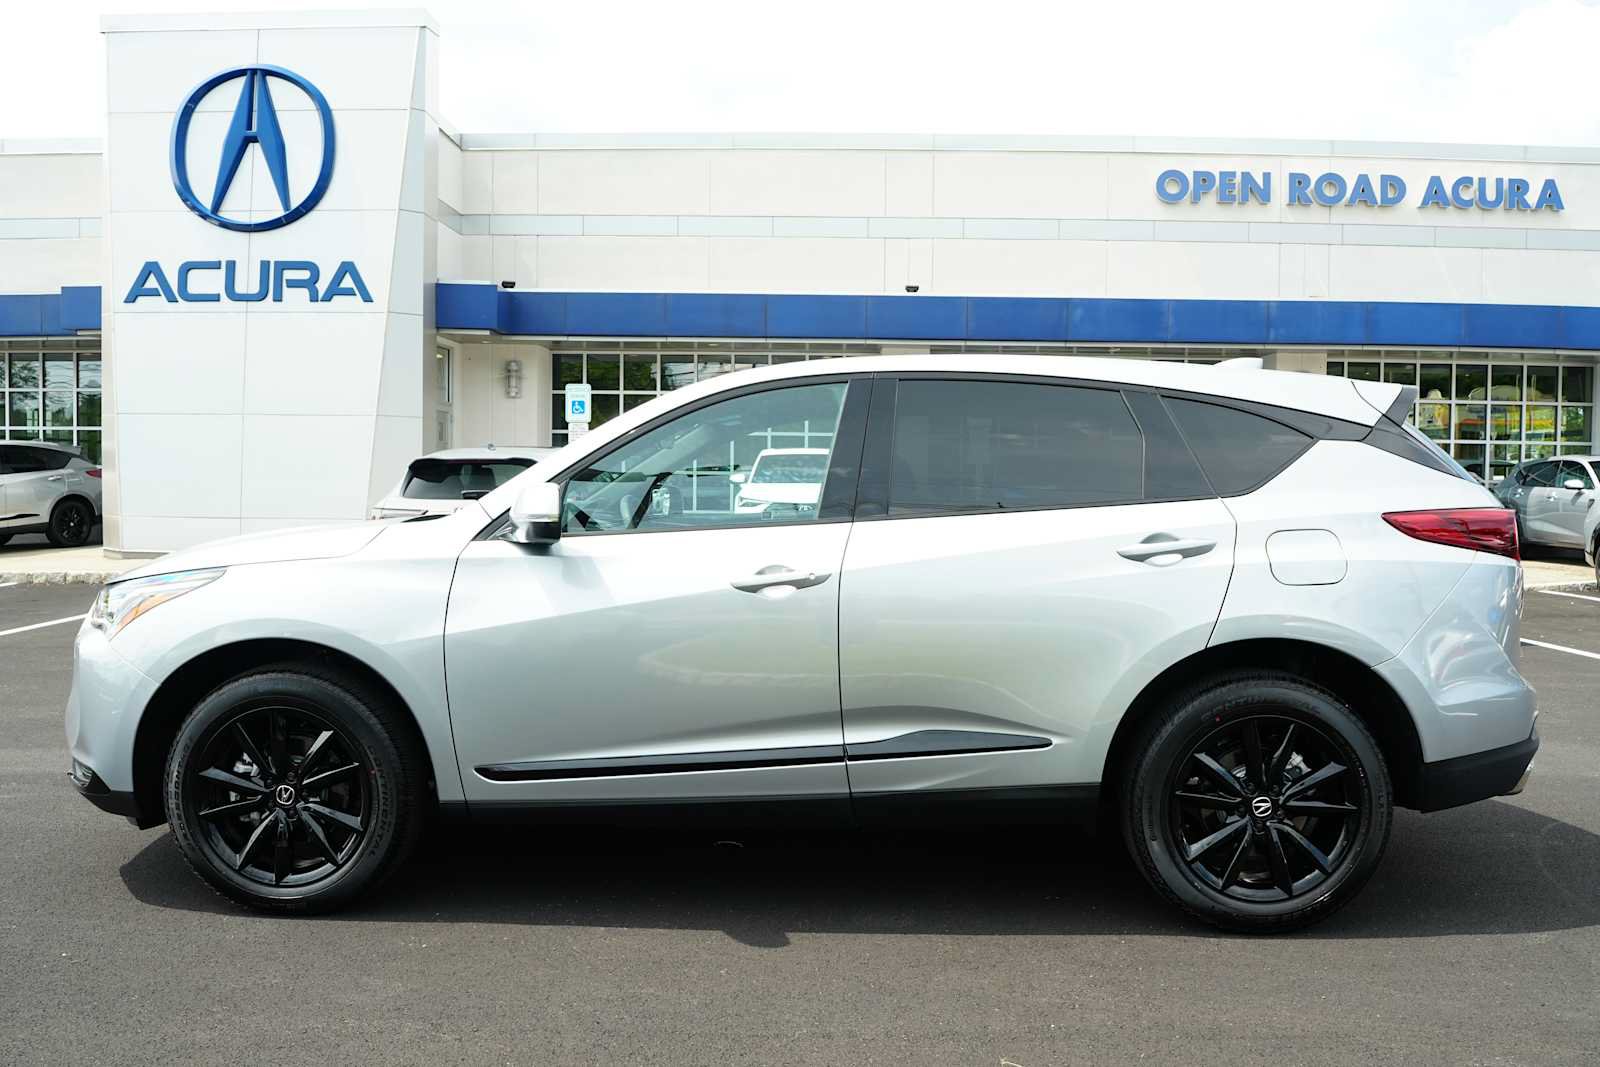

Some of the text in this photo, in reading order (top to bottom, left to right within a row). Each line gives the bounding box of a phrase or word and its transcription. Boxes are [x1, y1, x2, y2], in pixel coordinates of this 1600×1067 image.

[1155, 169, 1565, 210] OPEN ROAD ACURA
[124, 260, 373, 303] ACURA
